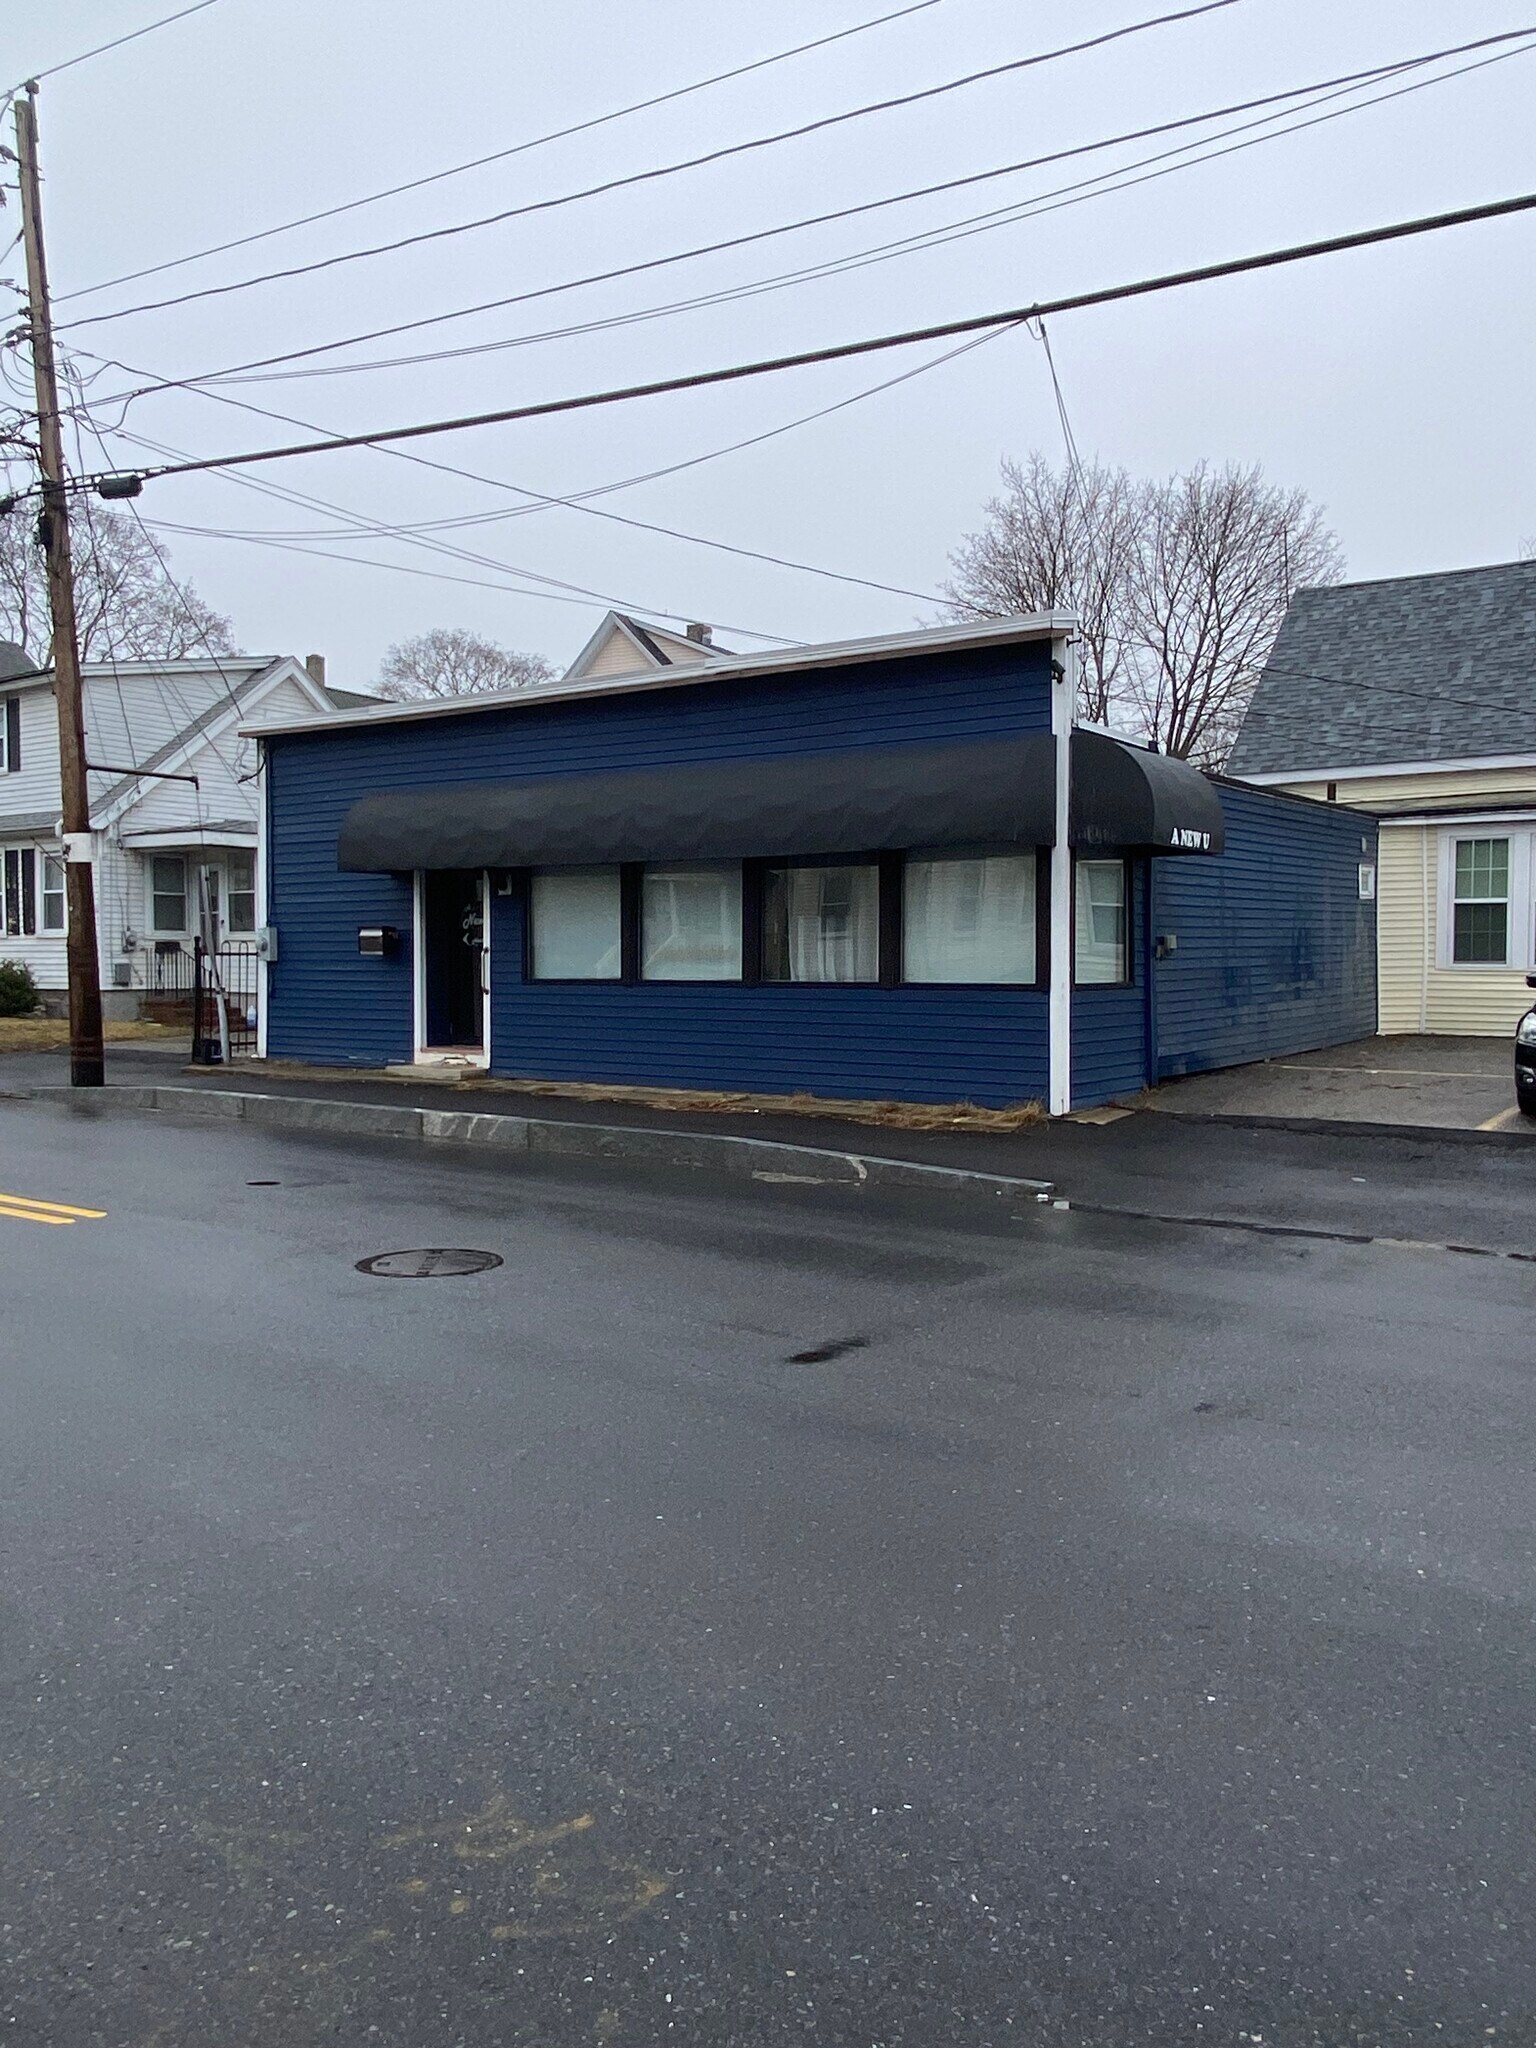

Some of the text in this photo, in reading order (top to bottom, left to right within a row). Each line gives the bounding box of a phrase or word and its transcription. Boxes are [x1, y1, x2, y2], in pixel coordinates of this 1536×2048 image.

[1170, 827, 1210, 850] A NEW U
